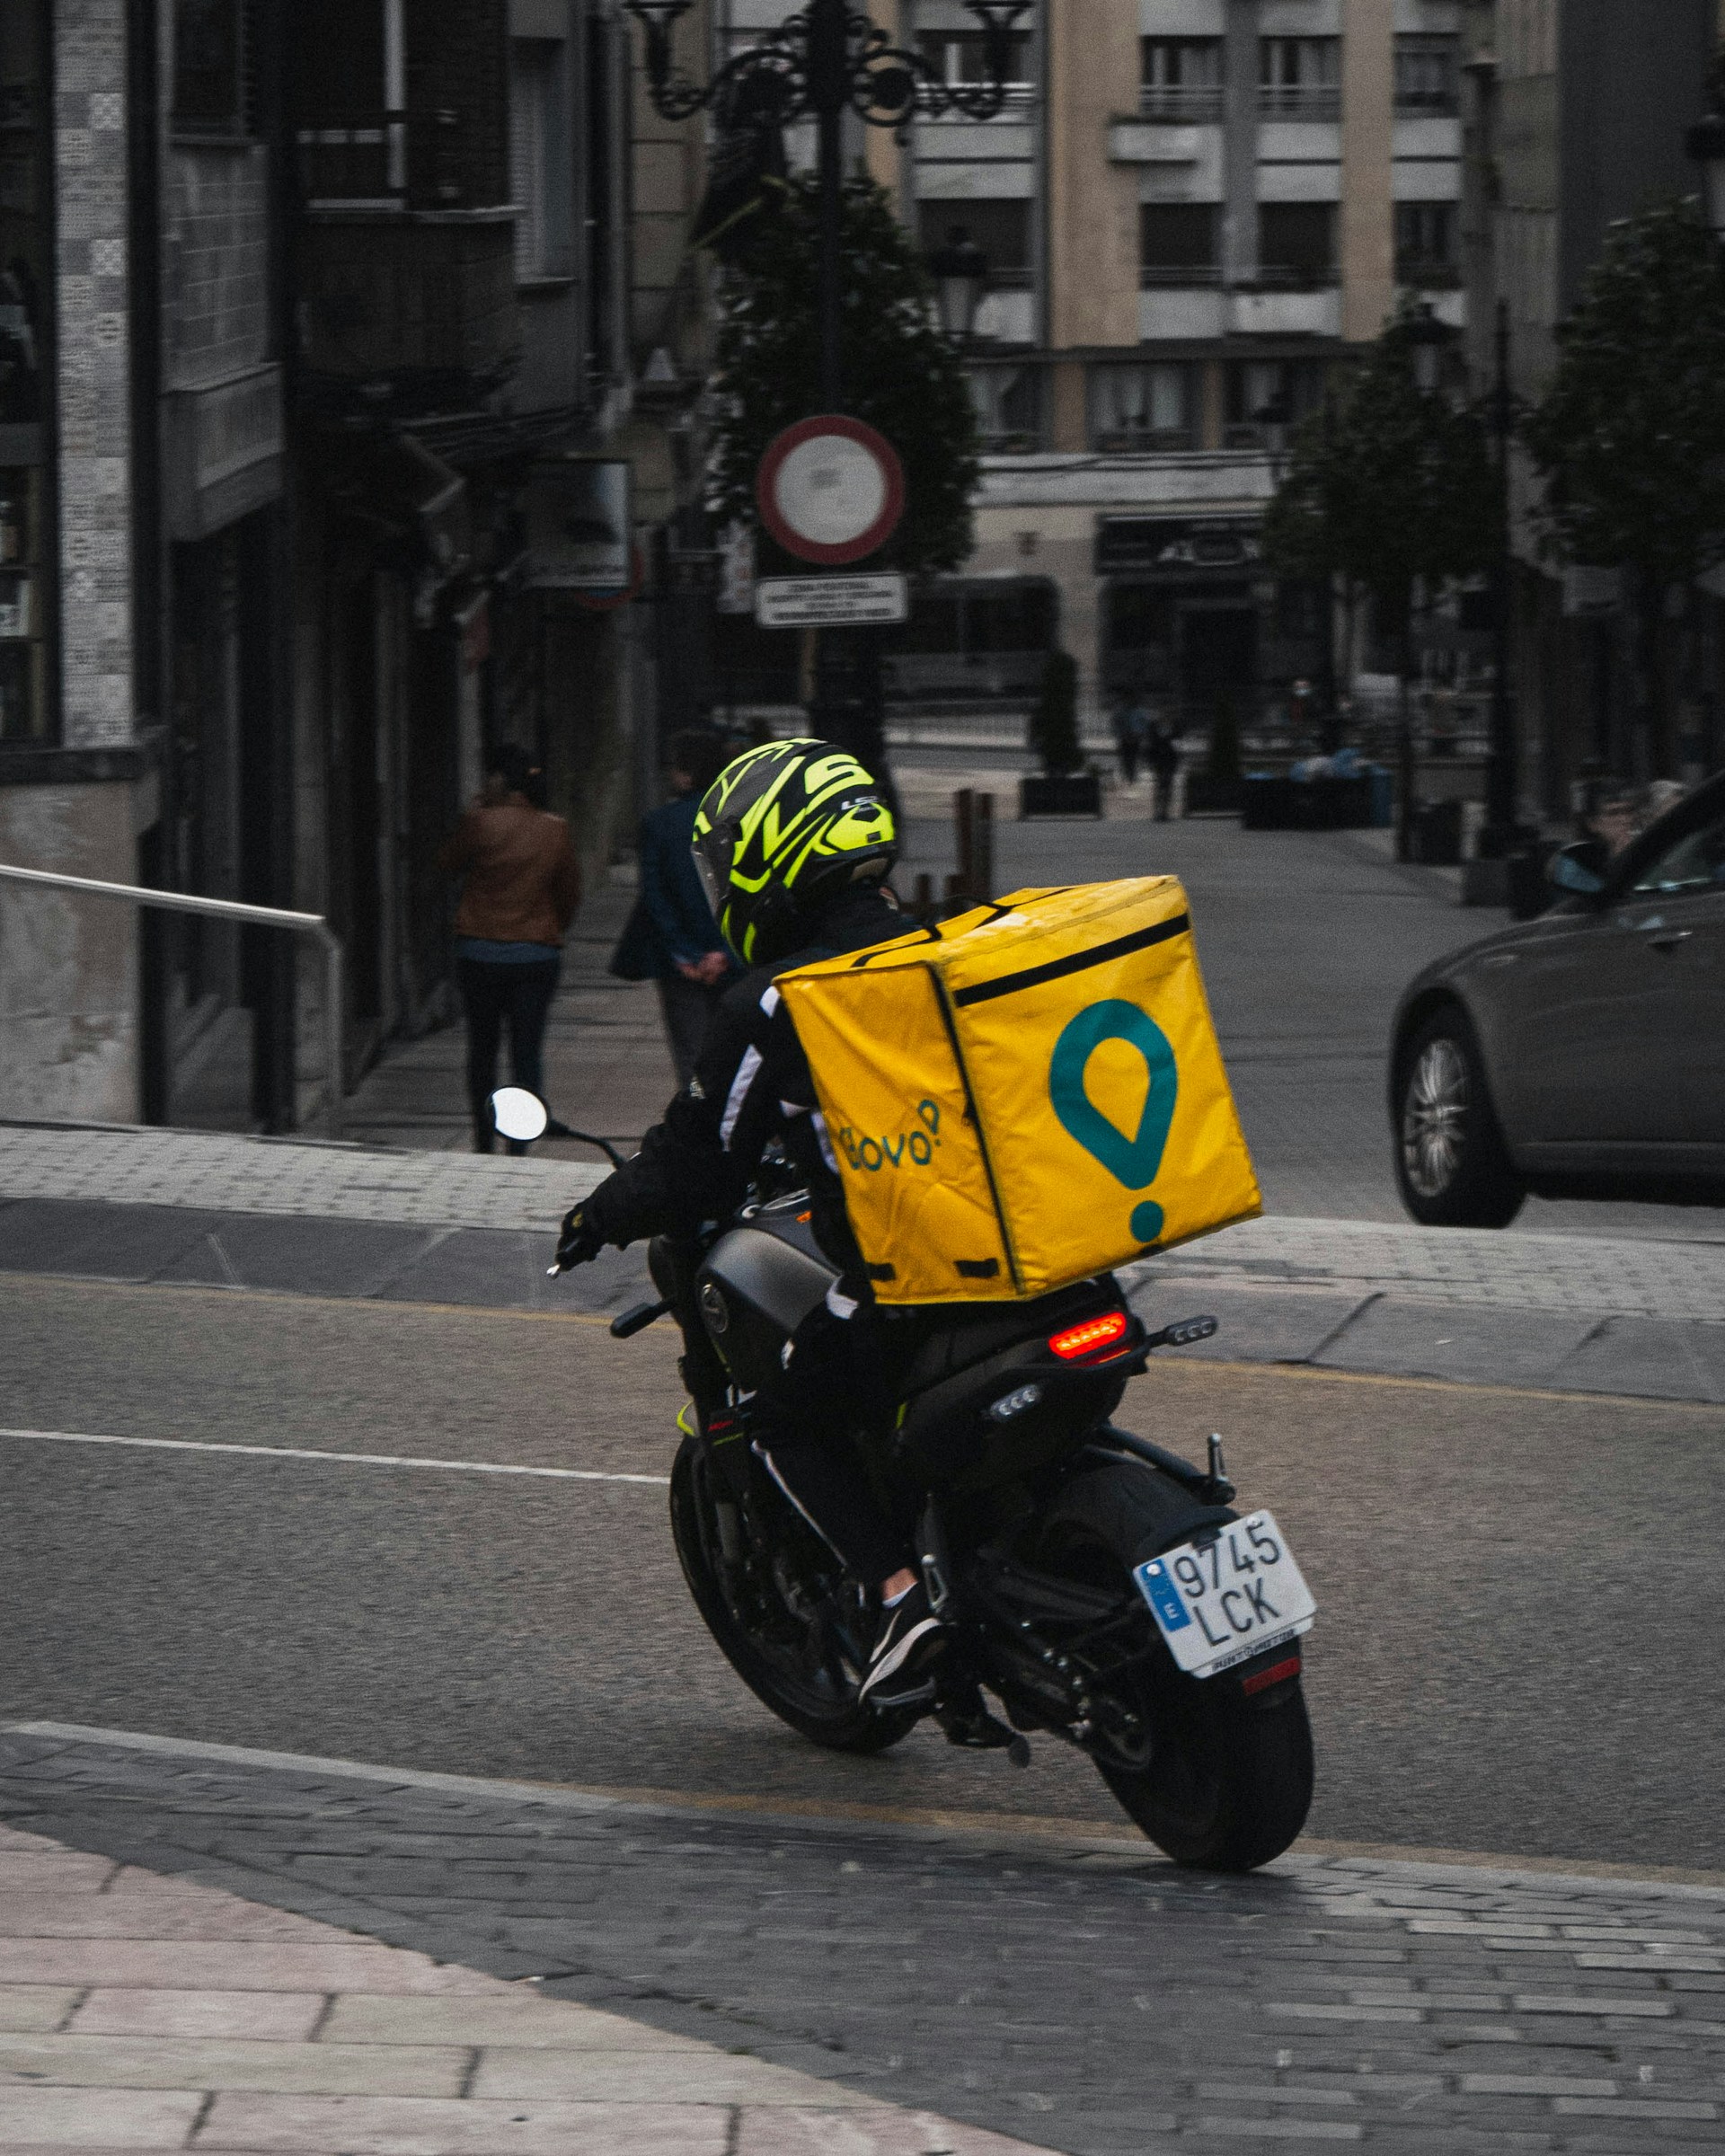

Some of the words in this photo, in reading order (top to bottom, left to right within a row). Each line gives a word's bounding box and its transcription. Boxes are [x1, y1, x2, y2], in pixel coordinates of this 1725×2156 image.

[839, 1127, 932, 1171] ovo
[1173, 1520, 1281, 1598] 9745
[1163, 1602, 1180, 1620] E
[1192, 1577, 1280, 1647] LCK
